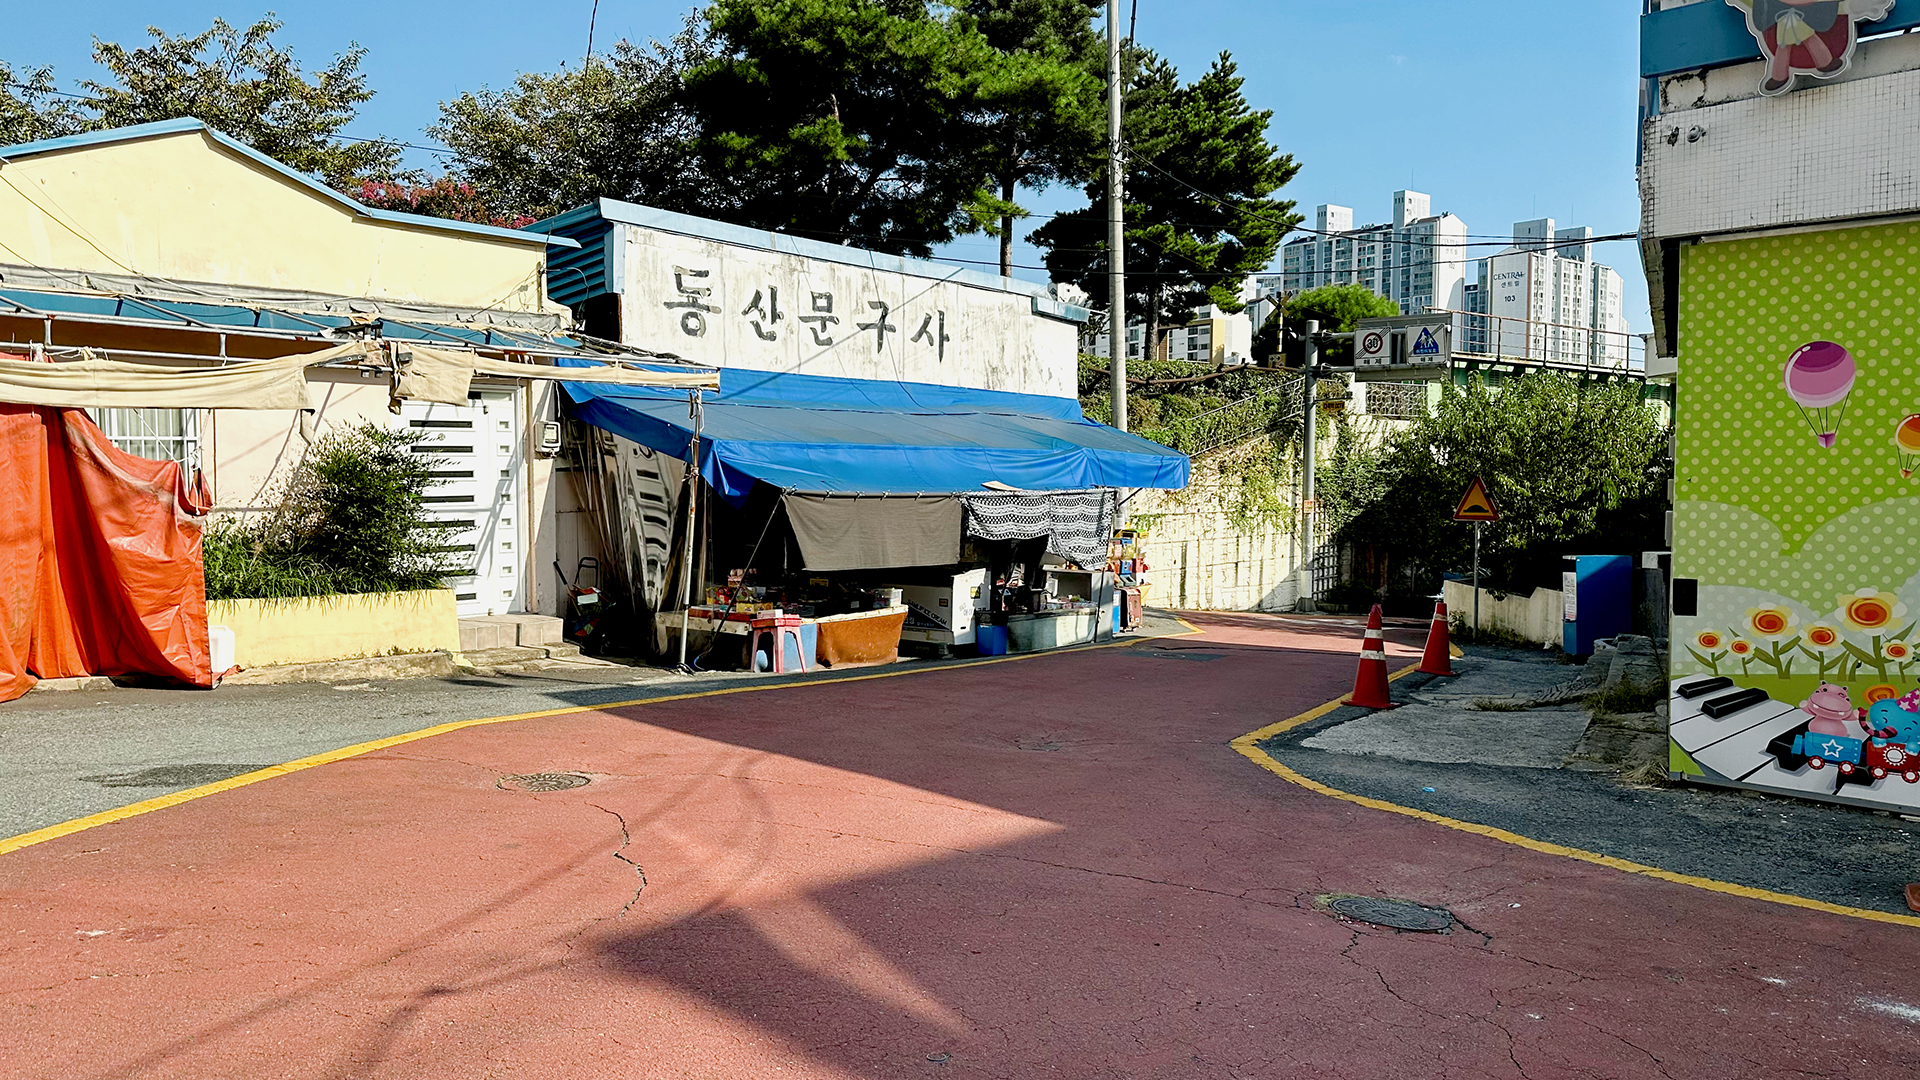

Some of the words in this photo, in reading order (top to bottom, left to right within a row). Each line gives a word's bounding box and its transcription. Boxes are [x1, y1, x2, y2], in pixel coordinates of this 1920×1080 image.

[1493, 271, 1526, 280] CENTRAL
[663, 265, 950, 363] 동산문구사
[1367, 339, 1379, 349] 30
[930, 612, 948, 625] CREAM
